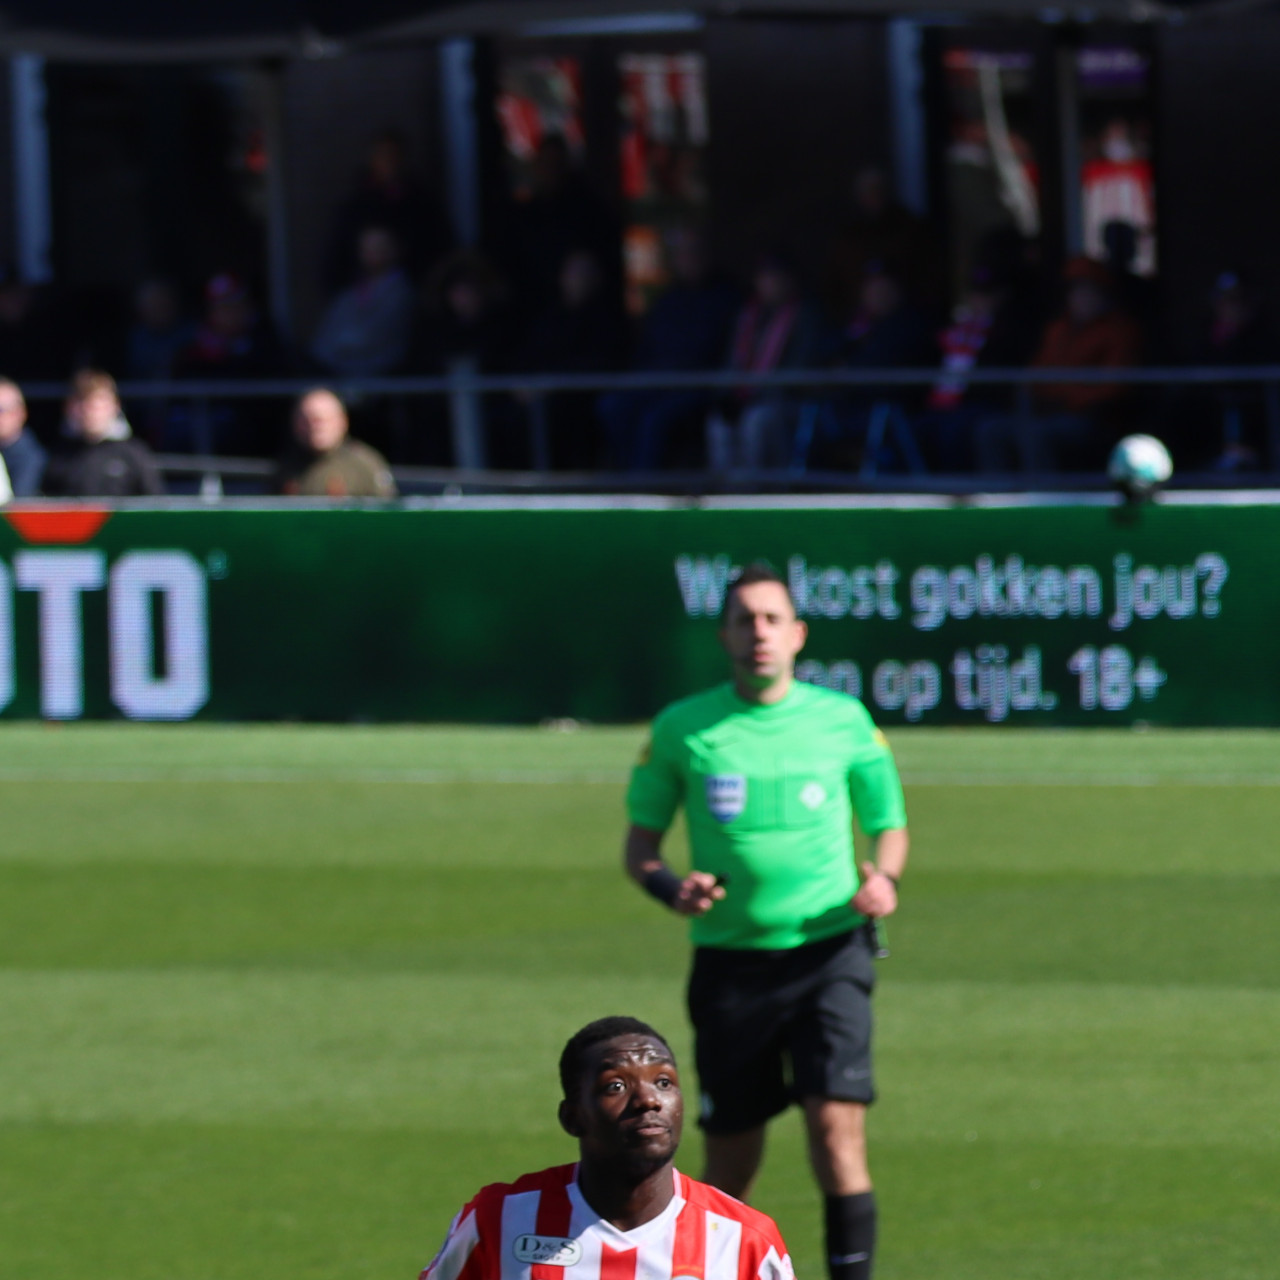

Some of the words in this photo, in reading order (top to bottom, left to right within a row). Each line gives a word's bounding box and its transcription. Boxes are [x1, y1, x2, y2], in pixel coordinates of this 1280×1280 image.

[788, 553, 899, 620] kost
[910, 553, 1103, 631] gokken
[1109, 552, 1228, 631] jou?
[0, 547, 212, 721] TO
[873, 659, 941, 723] op
[949, 642, 1056, 723] tijd.
[1067, 644, 1166, 712] 18+
[521, 1237, 576, 1255] D&S
